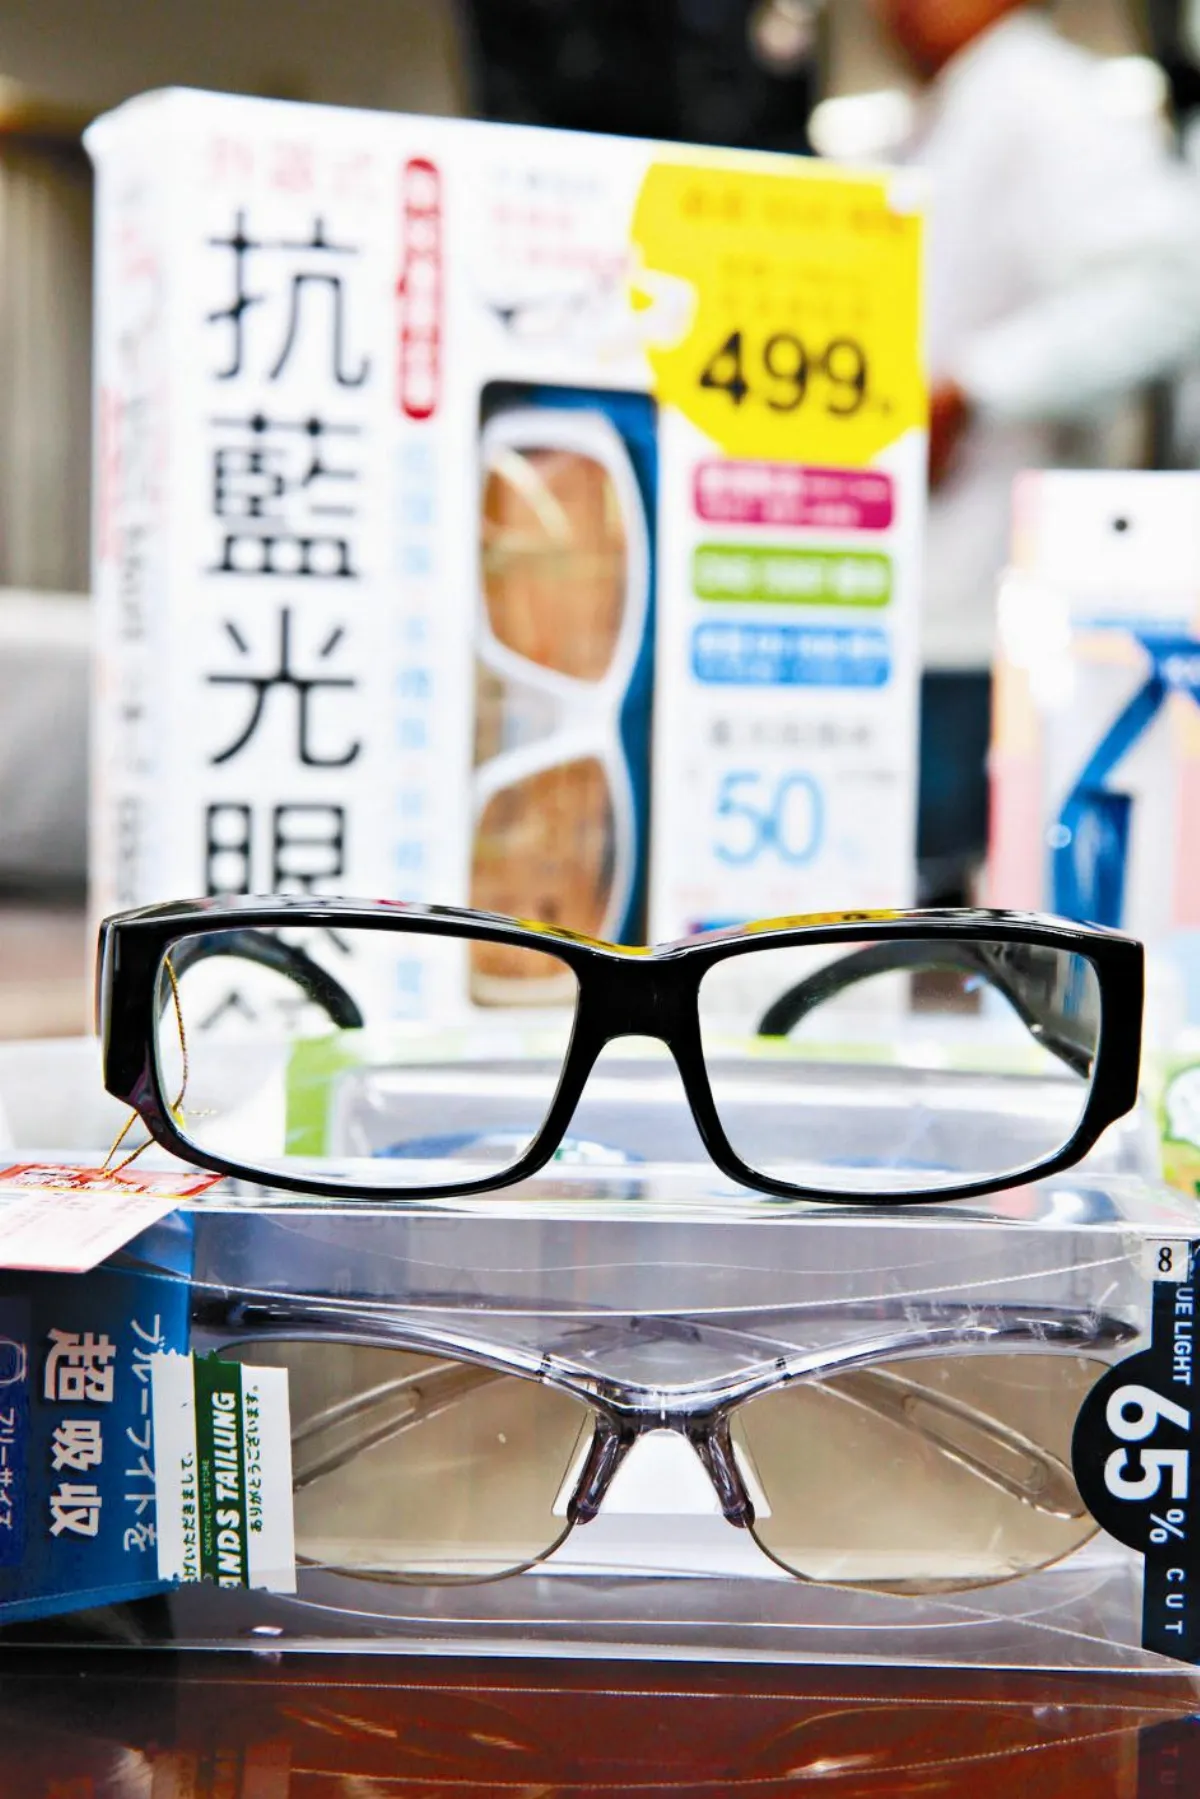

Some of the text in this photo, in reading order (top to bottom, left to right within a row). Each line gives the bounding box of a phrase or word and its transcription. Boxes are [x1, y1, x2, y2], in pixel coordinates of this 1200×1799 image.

[699, 329, 868, 418] 499
[204, 206, 372, 1030] 抗藍光眼
[713, 768, 824, 867] 50
[1172, 1321, 1194, 1386] LIGHT
[43, 1327, 117, 1539] 超吸収
[246, 1385, 263, 1533] ありがとうございます。
[182, 1452, 198, 1583] げいただきまして、
[201, 1458, 213, 1556] CREATIVE LIFE STORE
[1165, 1566, 1186, 1636] CUT
